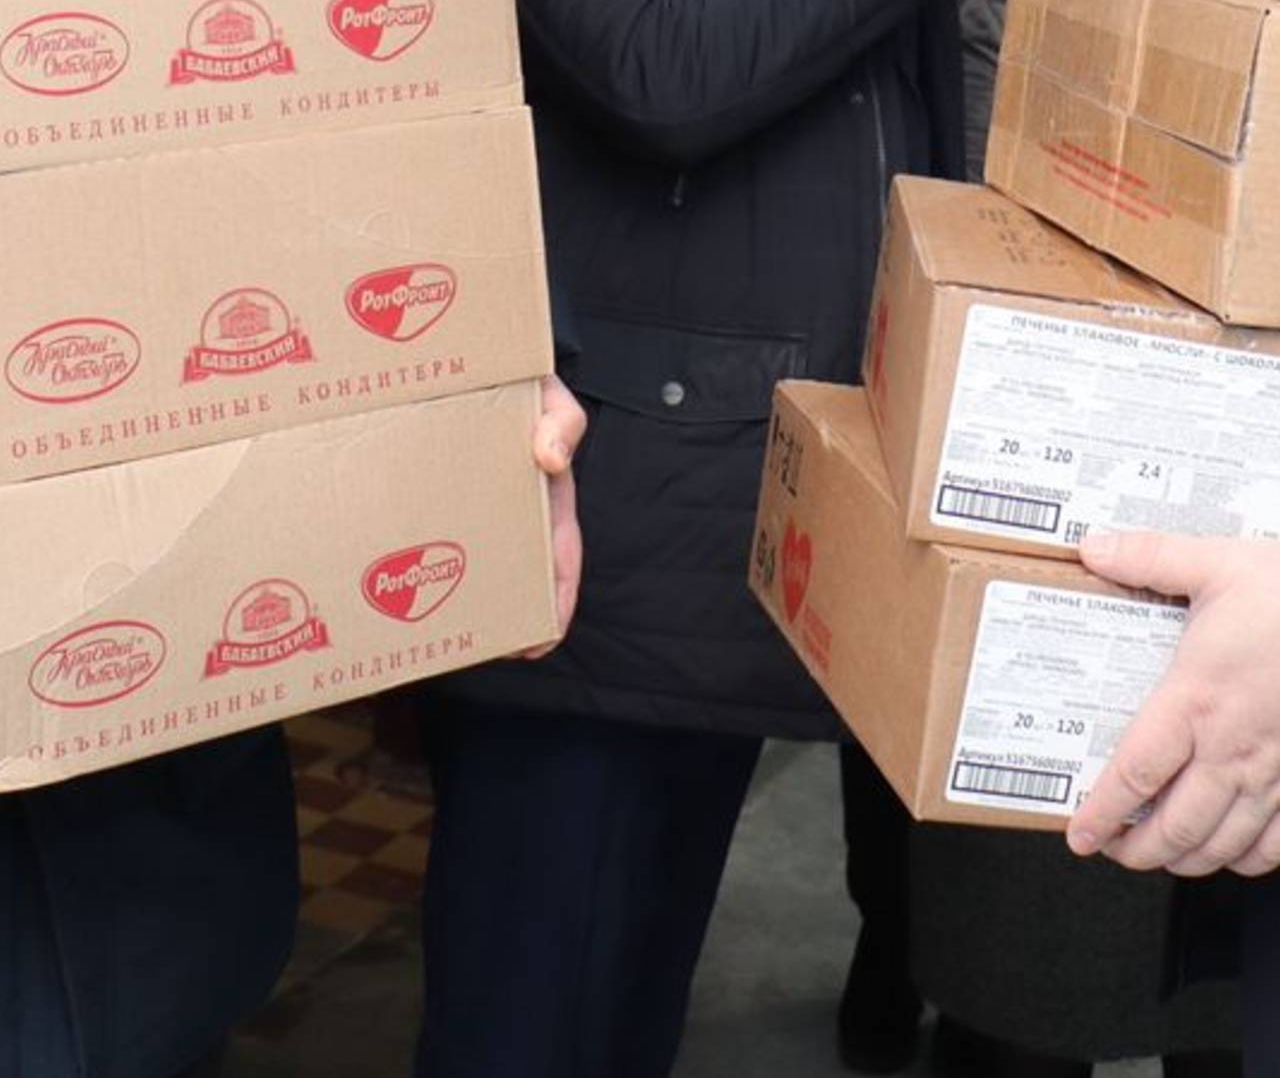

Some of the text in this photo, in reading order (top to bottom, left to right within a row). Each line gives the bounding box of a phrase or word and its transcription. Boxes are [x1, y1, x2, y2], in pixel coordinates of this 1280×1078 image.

[3, 81, 440, 149] ОБЪЕДИНЕННЫЕ КОНДИТЕРЫ
[1011, 315, 1068, 335] ПЕЧЕНЬЕ
[1073, 324, 1140, 348] ЗЛАКОВОЕ
[12, 357, 466, 459] ОБЪЕДИНЕННЫЕ КОНДИТЕРЫ
[999, 438, 1073, 464] 20 120
[943, 471, 990, 488] Артикул
[1137, 462, 1161, 480] 2,4
[1026, 589, 1081, 608] ПЕЧЕНЬЕ
[1087, 599, 1150, 620] ЗЛАКОВОЕ
[28, 632, 473, 760] ОБЪЕДИНЕННЫЕ КОНДИТЕРЫ
[1014, 712, 1085, 735] 20 120
[959, 746, 1003, 763] Артикул
